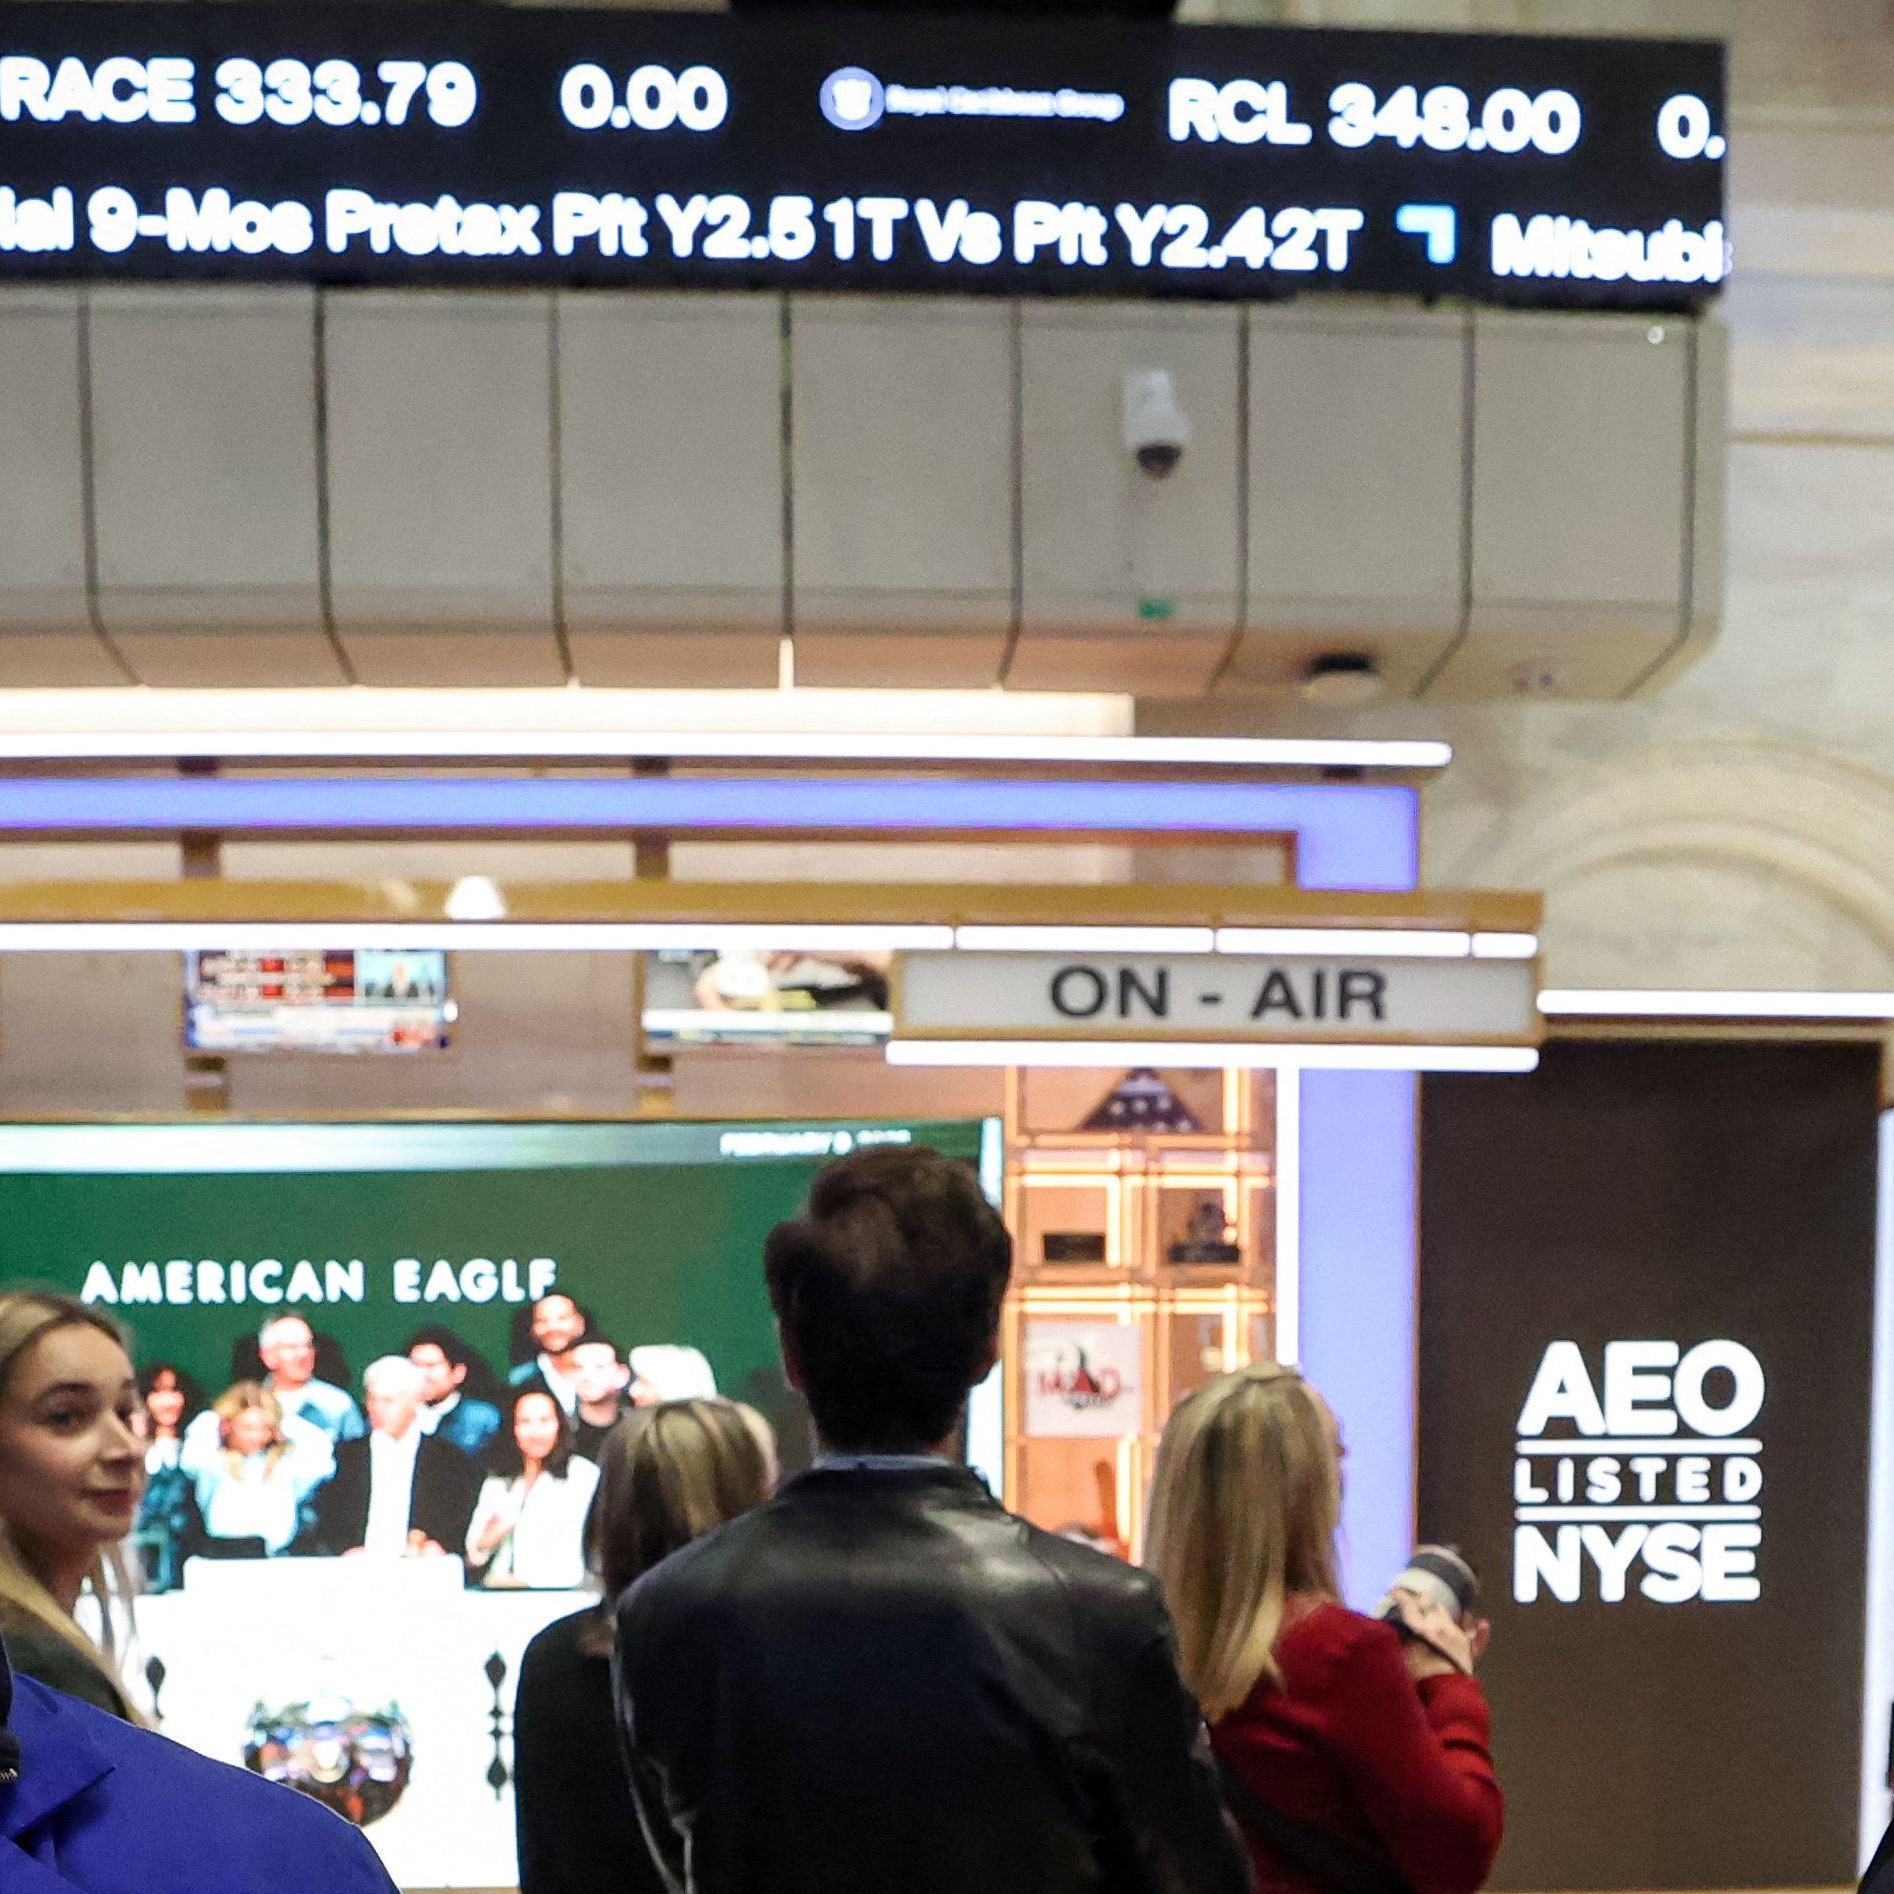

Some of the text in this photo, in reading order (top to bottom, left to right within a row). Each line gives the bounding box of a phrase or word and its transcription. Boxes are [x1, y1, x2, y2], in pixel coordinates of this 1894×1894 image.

[215, 58, 477, 127] 333.79
[560, 63, 728, 131] 0.00
[1168, 78, 1313, 145] RCL
[1328, 82, 1581, 154] 348.00
[87, 186, 314, 254] 9-Mos
[325, 189, 541, 256] Pretax
[914, 198, 1002, 265] Vs
[1114, 203, 1364, 271] Y2.42T
[1049, 965, 1169, 1019] ON
[1251, 968, 1388, 1021] AIR
[80, 1259, 364, 1304] AMERICAN
[1516, 1339, 1765, 1437] AEO
[1514, 1457, 1763, 1503] LISTED
[1513, 1523, 1762, 1603] NYSE
